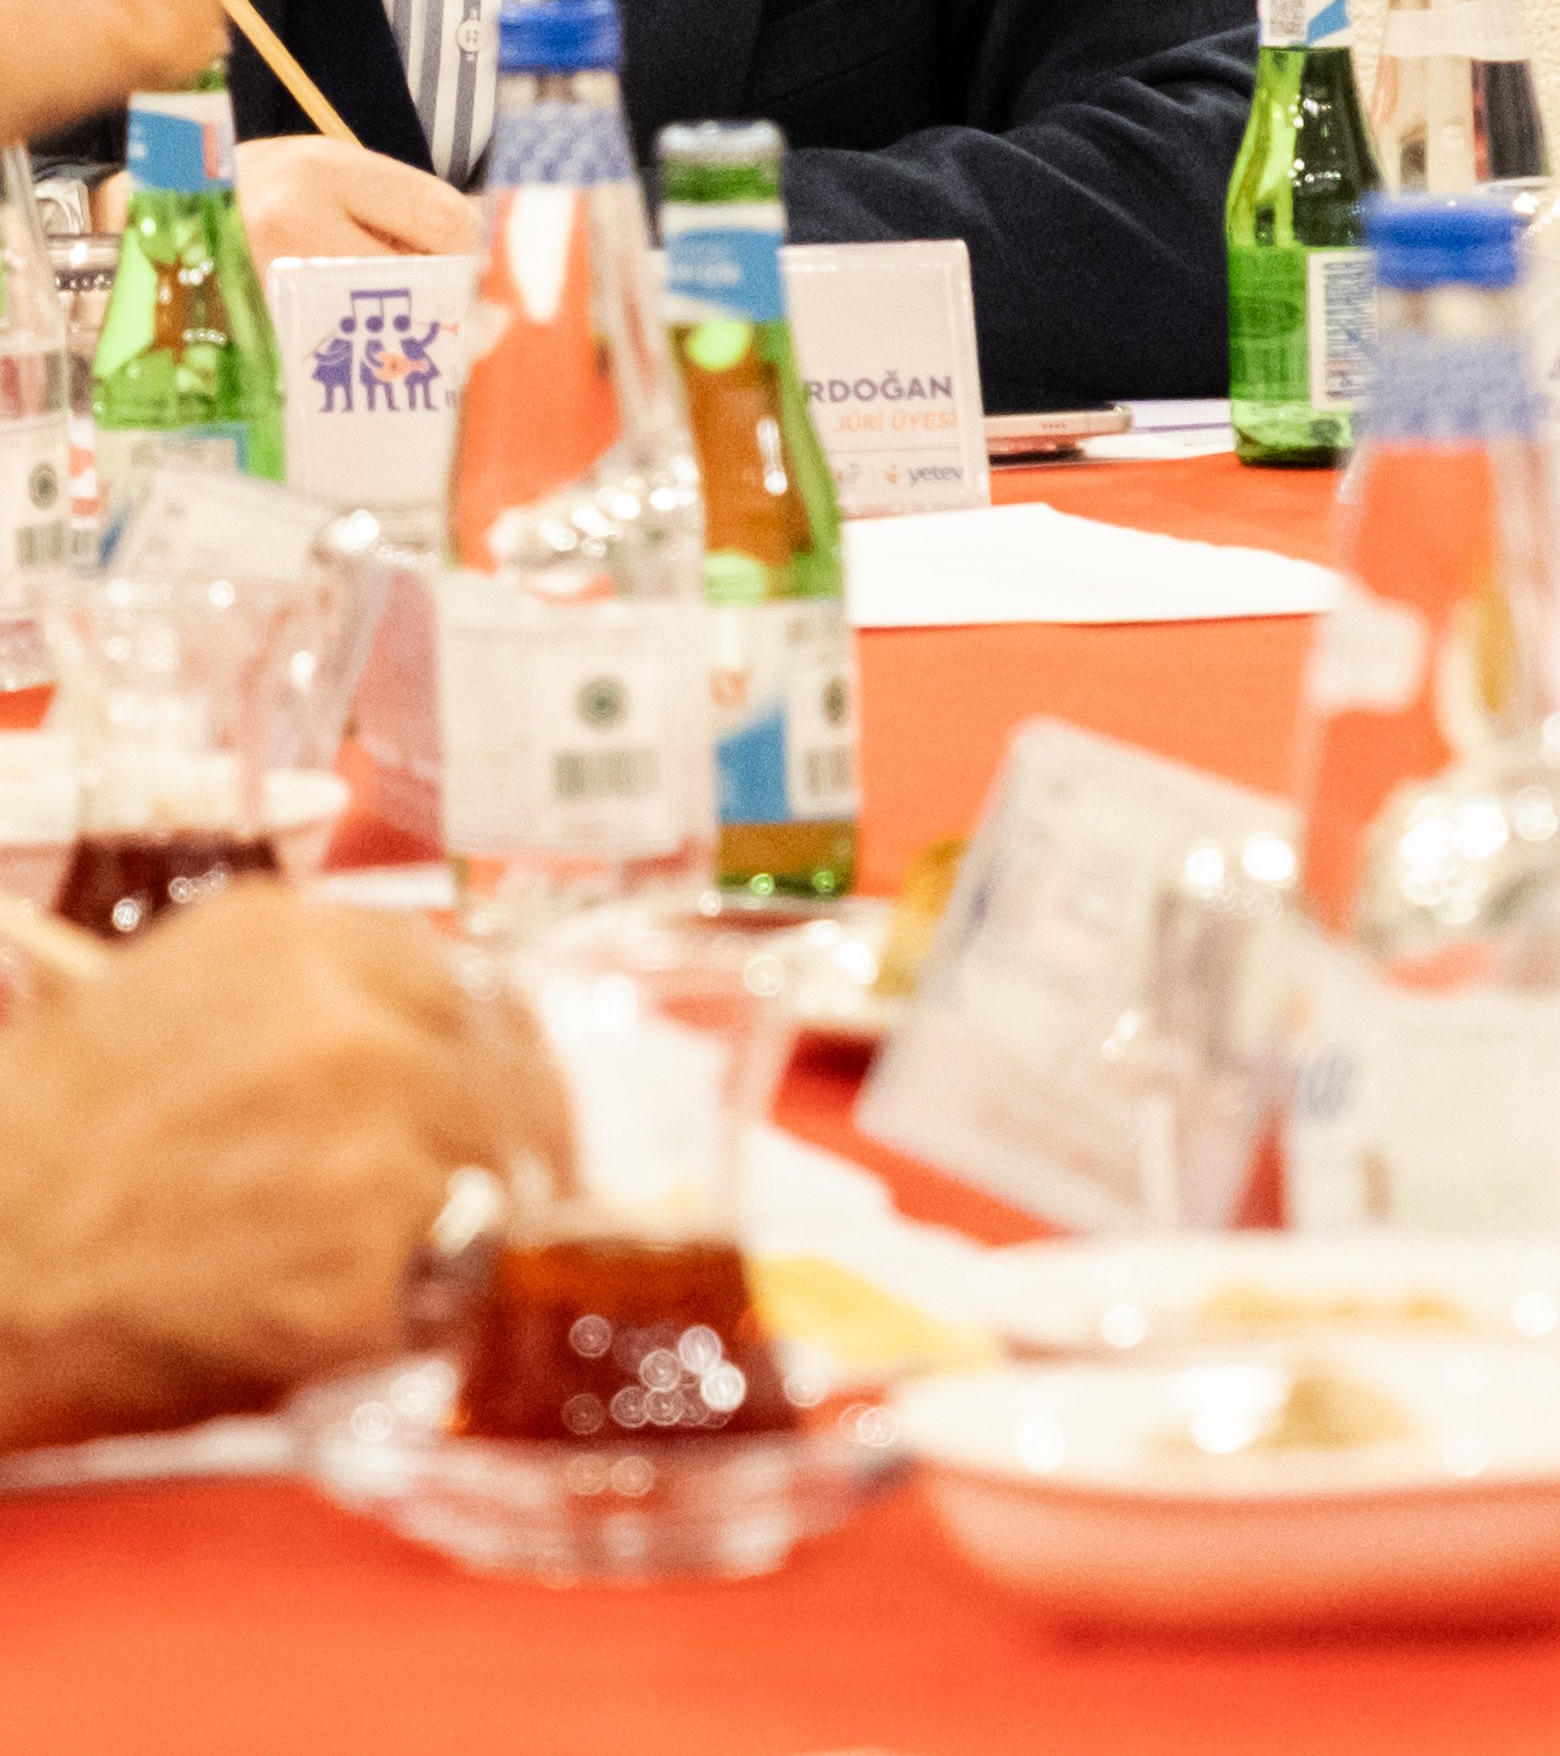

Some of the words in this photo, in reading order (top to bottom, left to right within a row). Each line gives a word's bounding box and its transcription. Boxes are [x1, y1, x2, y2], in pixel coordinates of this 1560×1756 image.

[802, 369, 953, 404] RDOĞAN
[834, 410, 885, 433] JÜRİ
[890, 406, 958, 431] ÜYESİ
[906, 465, 964, 487] yetev
